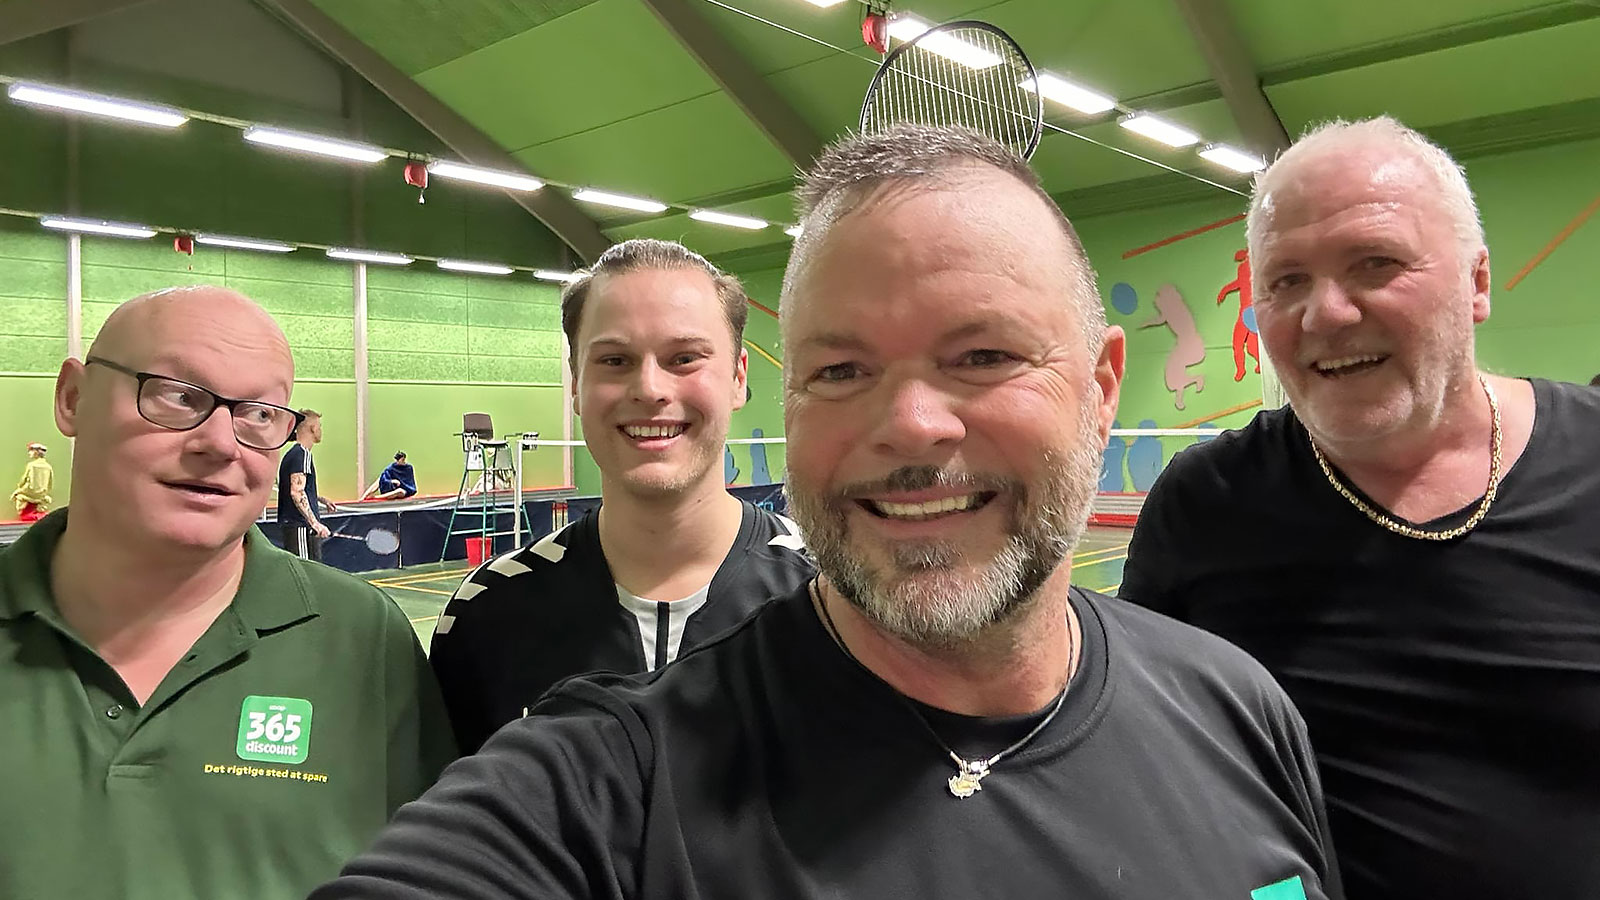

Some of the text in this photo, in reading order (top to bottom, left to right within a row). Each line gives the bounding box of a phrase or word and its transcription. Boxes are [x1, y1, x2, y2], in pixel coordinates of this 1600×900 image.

[246, 711, 301, 743] 365
[245, 741, 298, 756] discount
[204, 764, 328, 783] Det rigtige sted at spare
